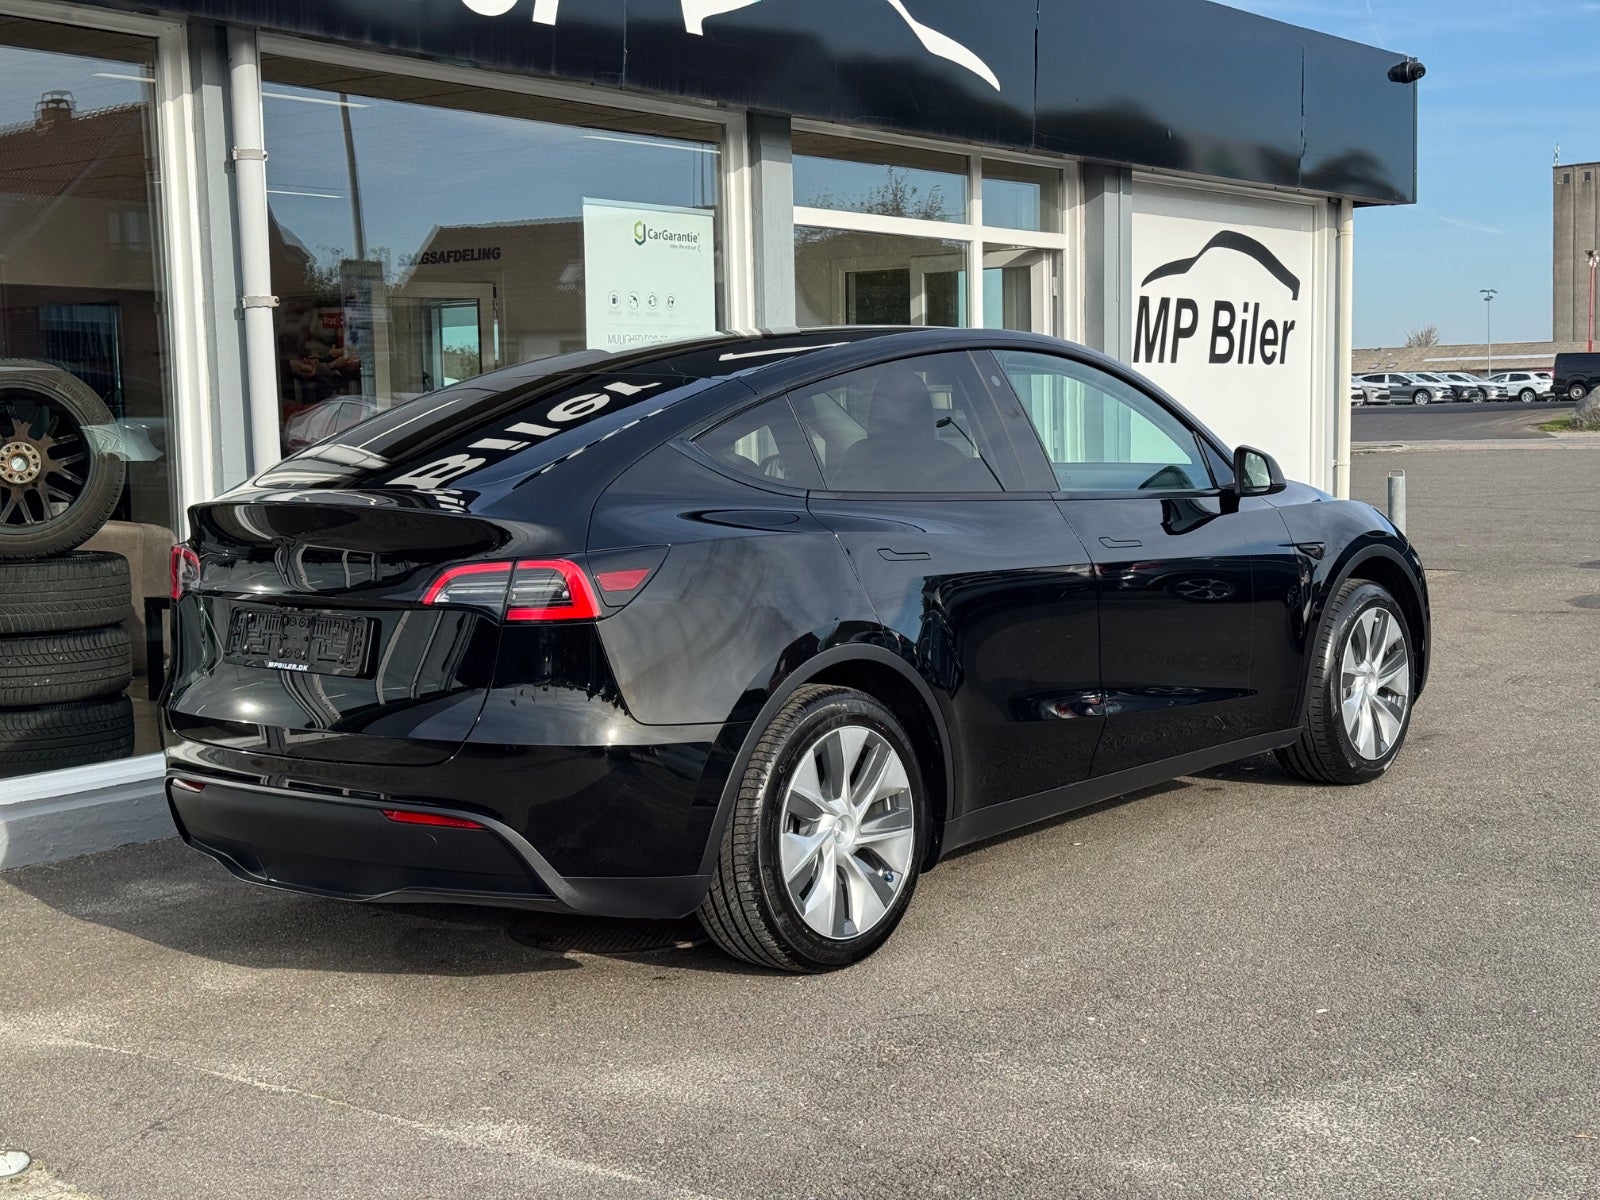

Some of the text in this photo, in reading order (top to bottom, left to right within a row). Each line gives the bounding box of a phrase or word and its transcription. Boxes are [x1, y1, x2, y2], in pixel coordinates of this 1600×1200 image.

[647, 228, 699, 243] CarGarantie
[1133, 295, 1296, 365] MP Biler
